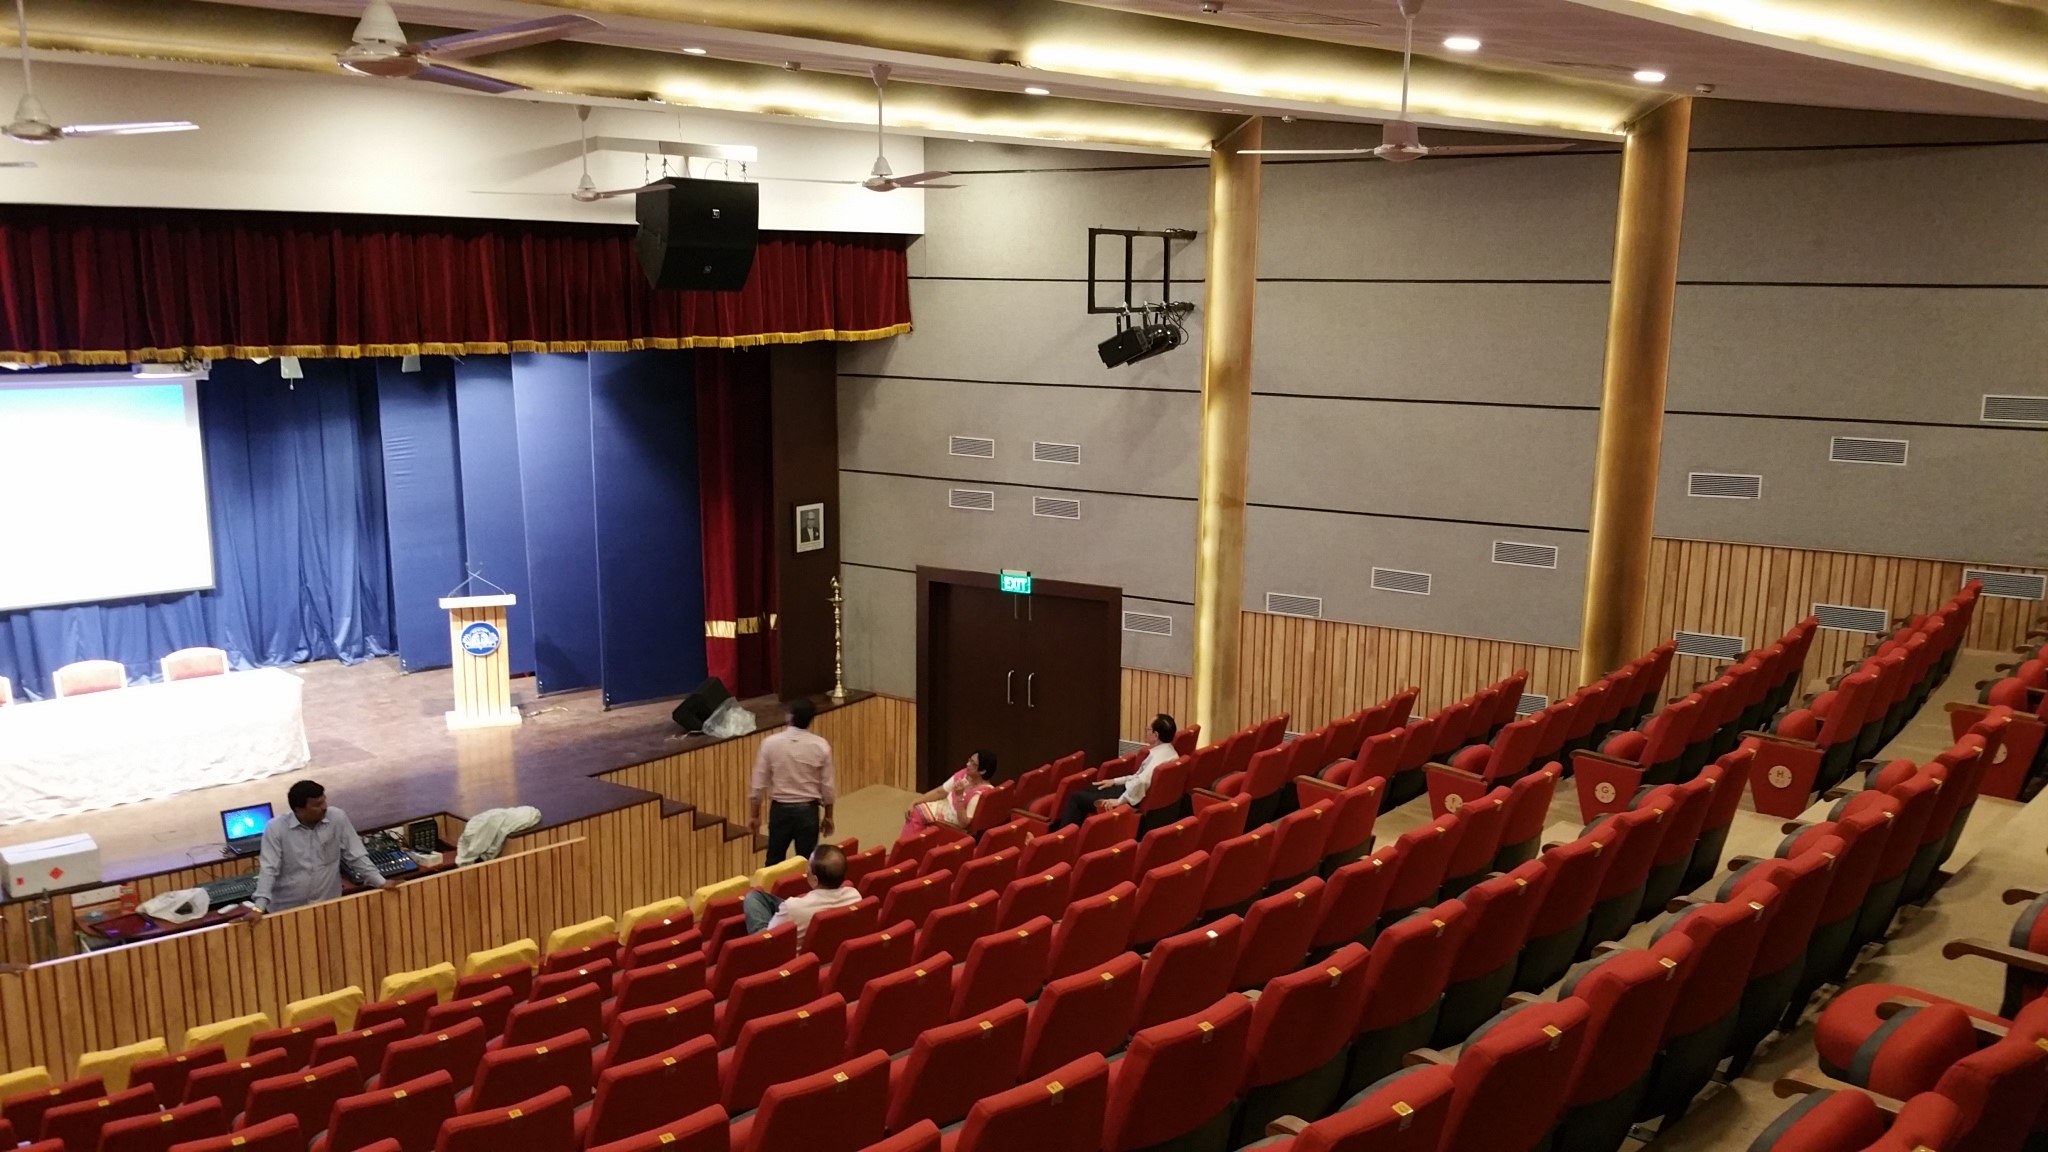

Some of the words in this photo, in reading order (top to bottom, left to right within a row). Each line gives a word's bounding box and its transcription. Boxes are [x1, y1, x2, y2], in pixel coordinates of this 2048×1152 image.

[1004, 576, 1027, 591] EXIT
[1776, 769, 1785, 777] H
[1601, 785, 1610, 794] G
